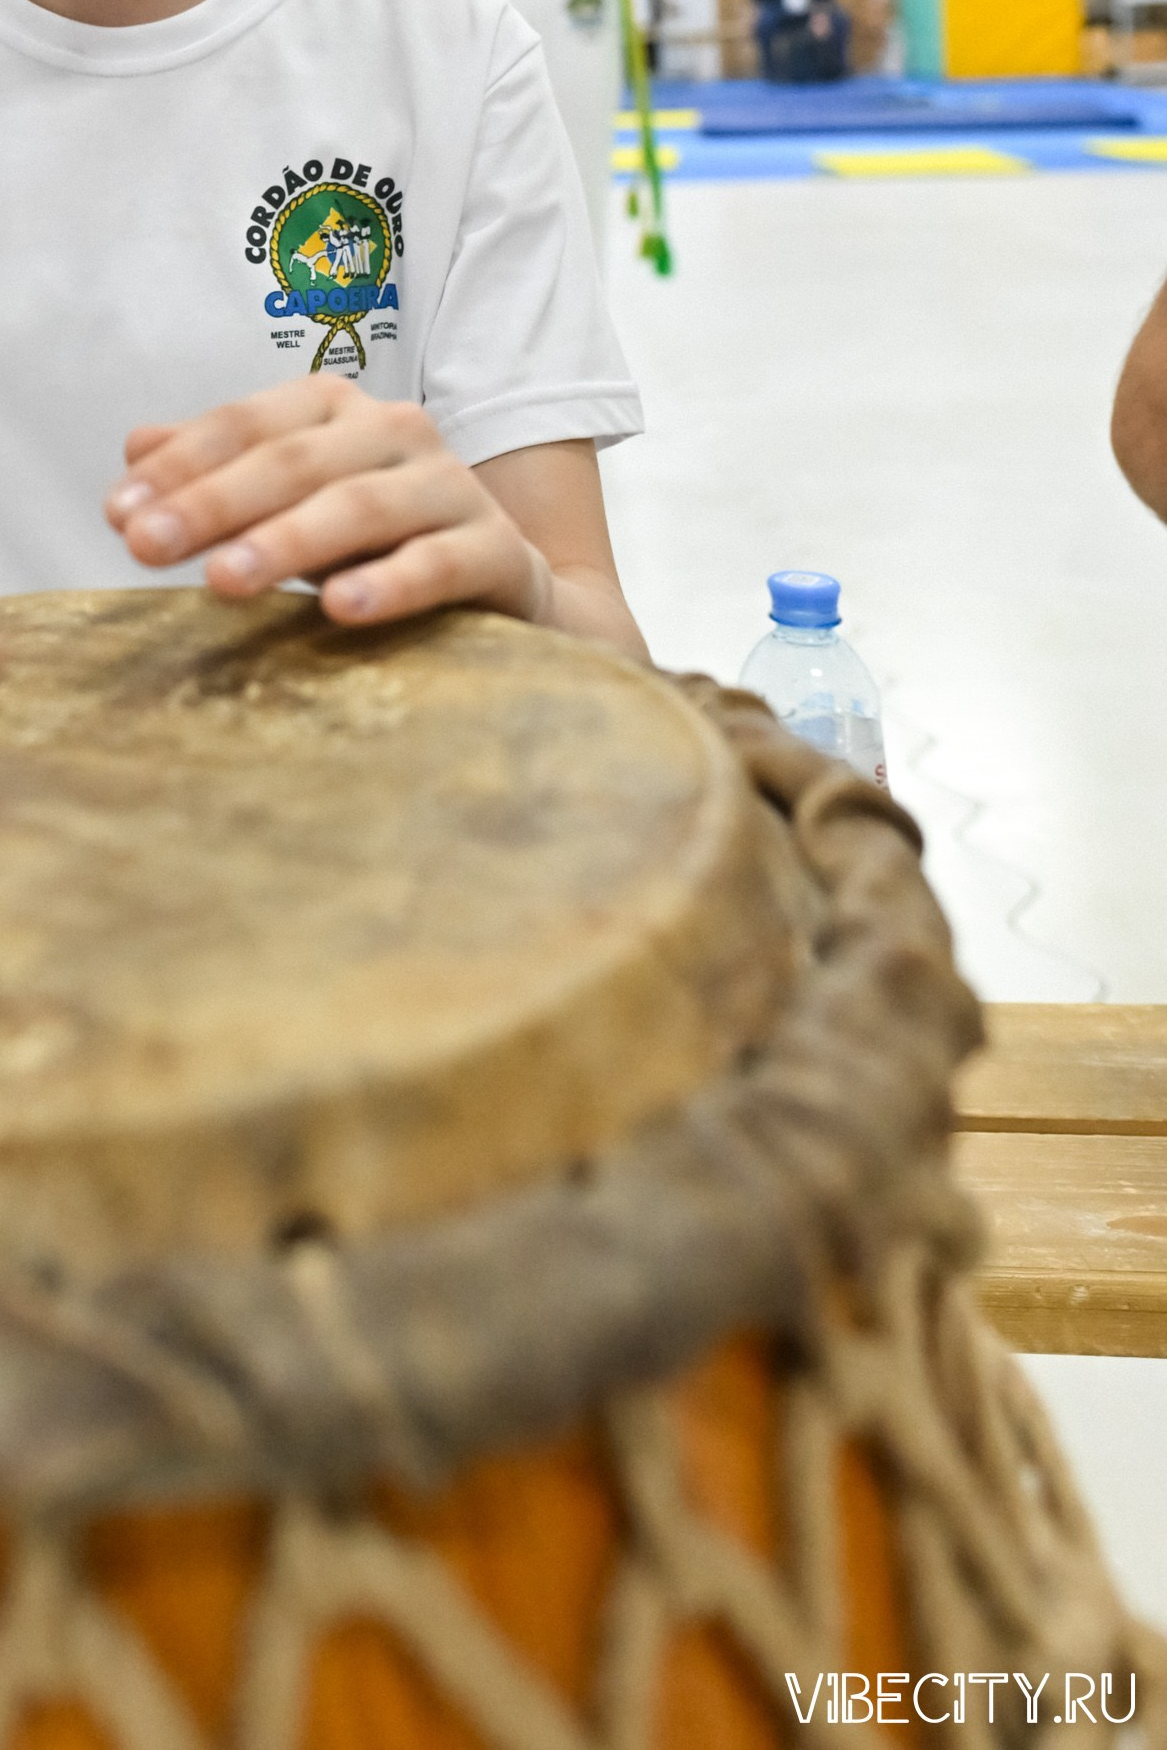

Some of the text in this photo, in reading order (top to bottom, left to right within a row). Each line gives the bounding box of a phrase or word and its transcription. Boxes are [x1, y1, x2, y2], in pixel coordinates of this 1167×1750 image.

[245, 158, 404, 264] CORDÃO DE OURO
[264, 283, 399, 318] CAPOEIRA
[270, 329, 306, 339] MESTRE
[276, 340, 300, 349] WELL
[328, 346, 355, 355] MESTRE
[323, 355, 358, 366] SUASSUNA
